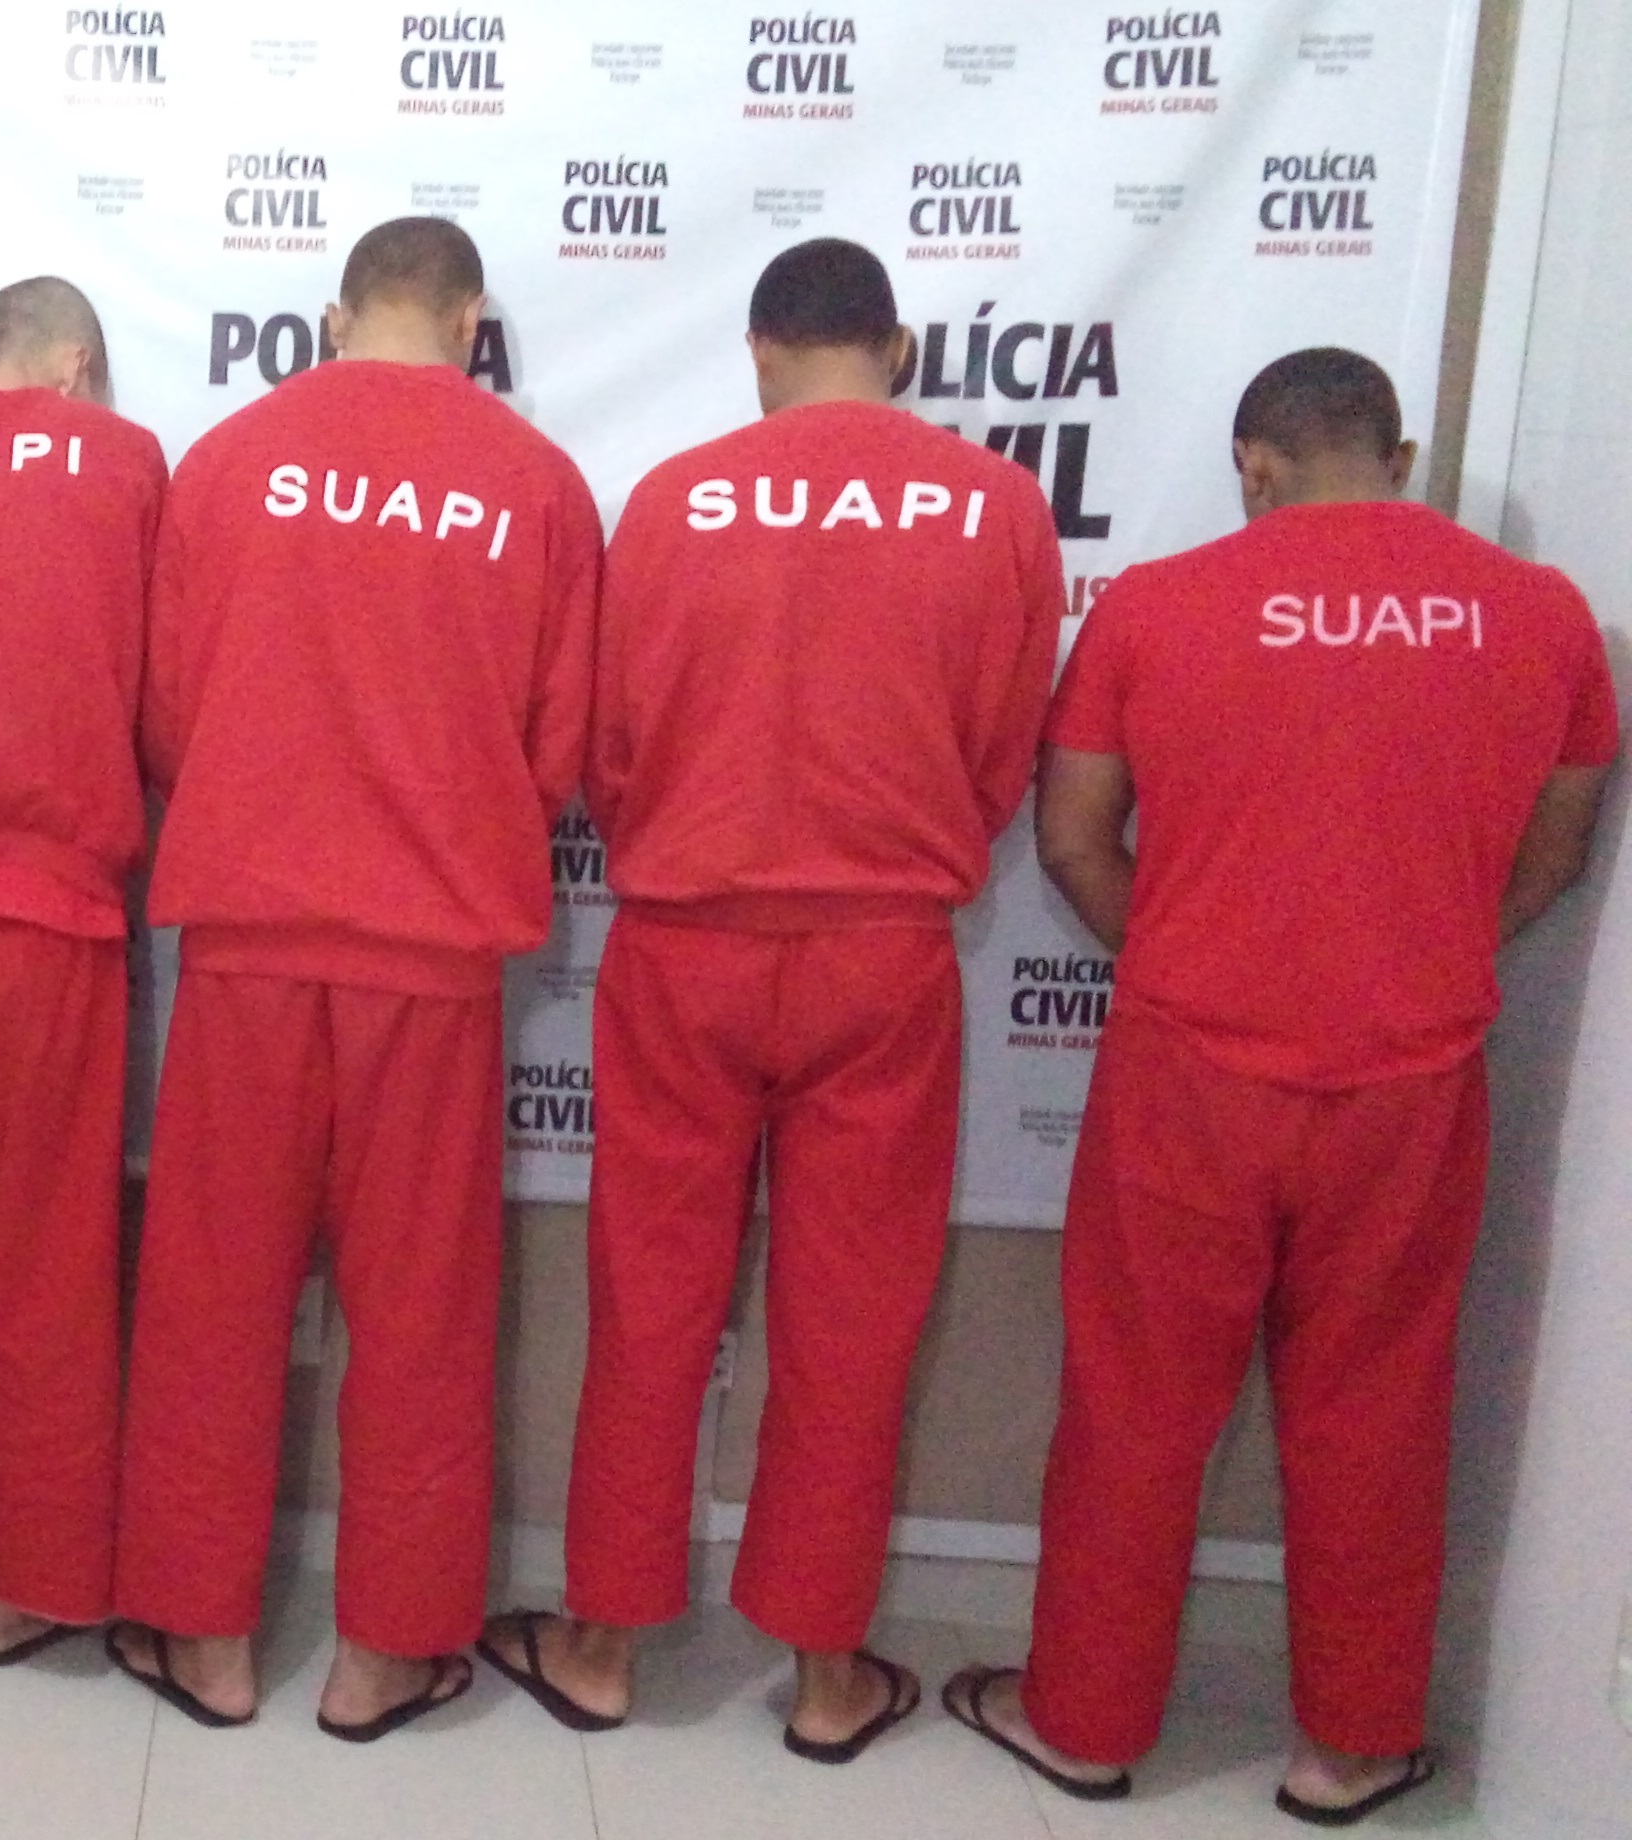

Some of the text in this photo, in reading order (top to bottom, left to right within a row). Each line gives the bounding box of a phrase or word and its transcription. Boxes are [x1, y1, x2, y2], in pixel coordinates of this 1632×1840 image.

[65, 4, 166, 37] POLÍCIA
[402, 8, 506, 42] POLÍCIA
[749, 11, 856, 44] POLÍCIA
[1106, 7, 1222, 43] POLÍCIA
[65, 44, 167, 84] CIVIL
[400, 49, 505, 90] CIVIL
[747, 53, 854, 94] CIVIL
[1104, 46, 1219, 89] CIVIL
[398, 99, 504, 116] MINAS GERAIS
[743, 103, 854, 120] MINAS GERAIS
[1100, 97, 1218, 114] MINAS GERAIS
[227, 148, 328, 182] POLÍCIA
[565, 154, 669, 187] POLÍCIA
[911, 157, 1022, 190] POLÍCIA
[1262, 147, 1377, 183] POLÍCIA
[225, 188, 327, 229] CIVIL
[562, 195, 666, 236] CIVIL
[909, 195, 1021, 237] CIVIL
[1259, 189, 1374, 231] CIVIL
[223, 236, 327, 253] MINAS GERAIS
[559, 244, 666, 261] MINAS GERAIS
[906, 244, 1021, 260] MINAS GERAIS
[1255, 240, 1372, 257] MINAS GERAIS
[889, 300, 1118, 399] LÍCIA
[264, 464, 511, 560] SUAPI
[686, 476, 985, 538] SUAPI
[1259, 594, 1482, 648] SUAPI
[510, 1059, 593, 1089] POLÍCI
